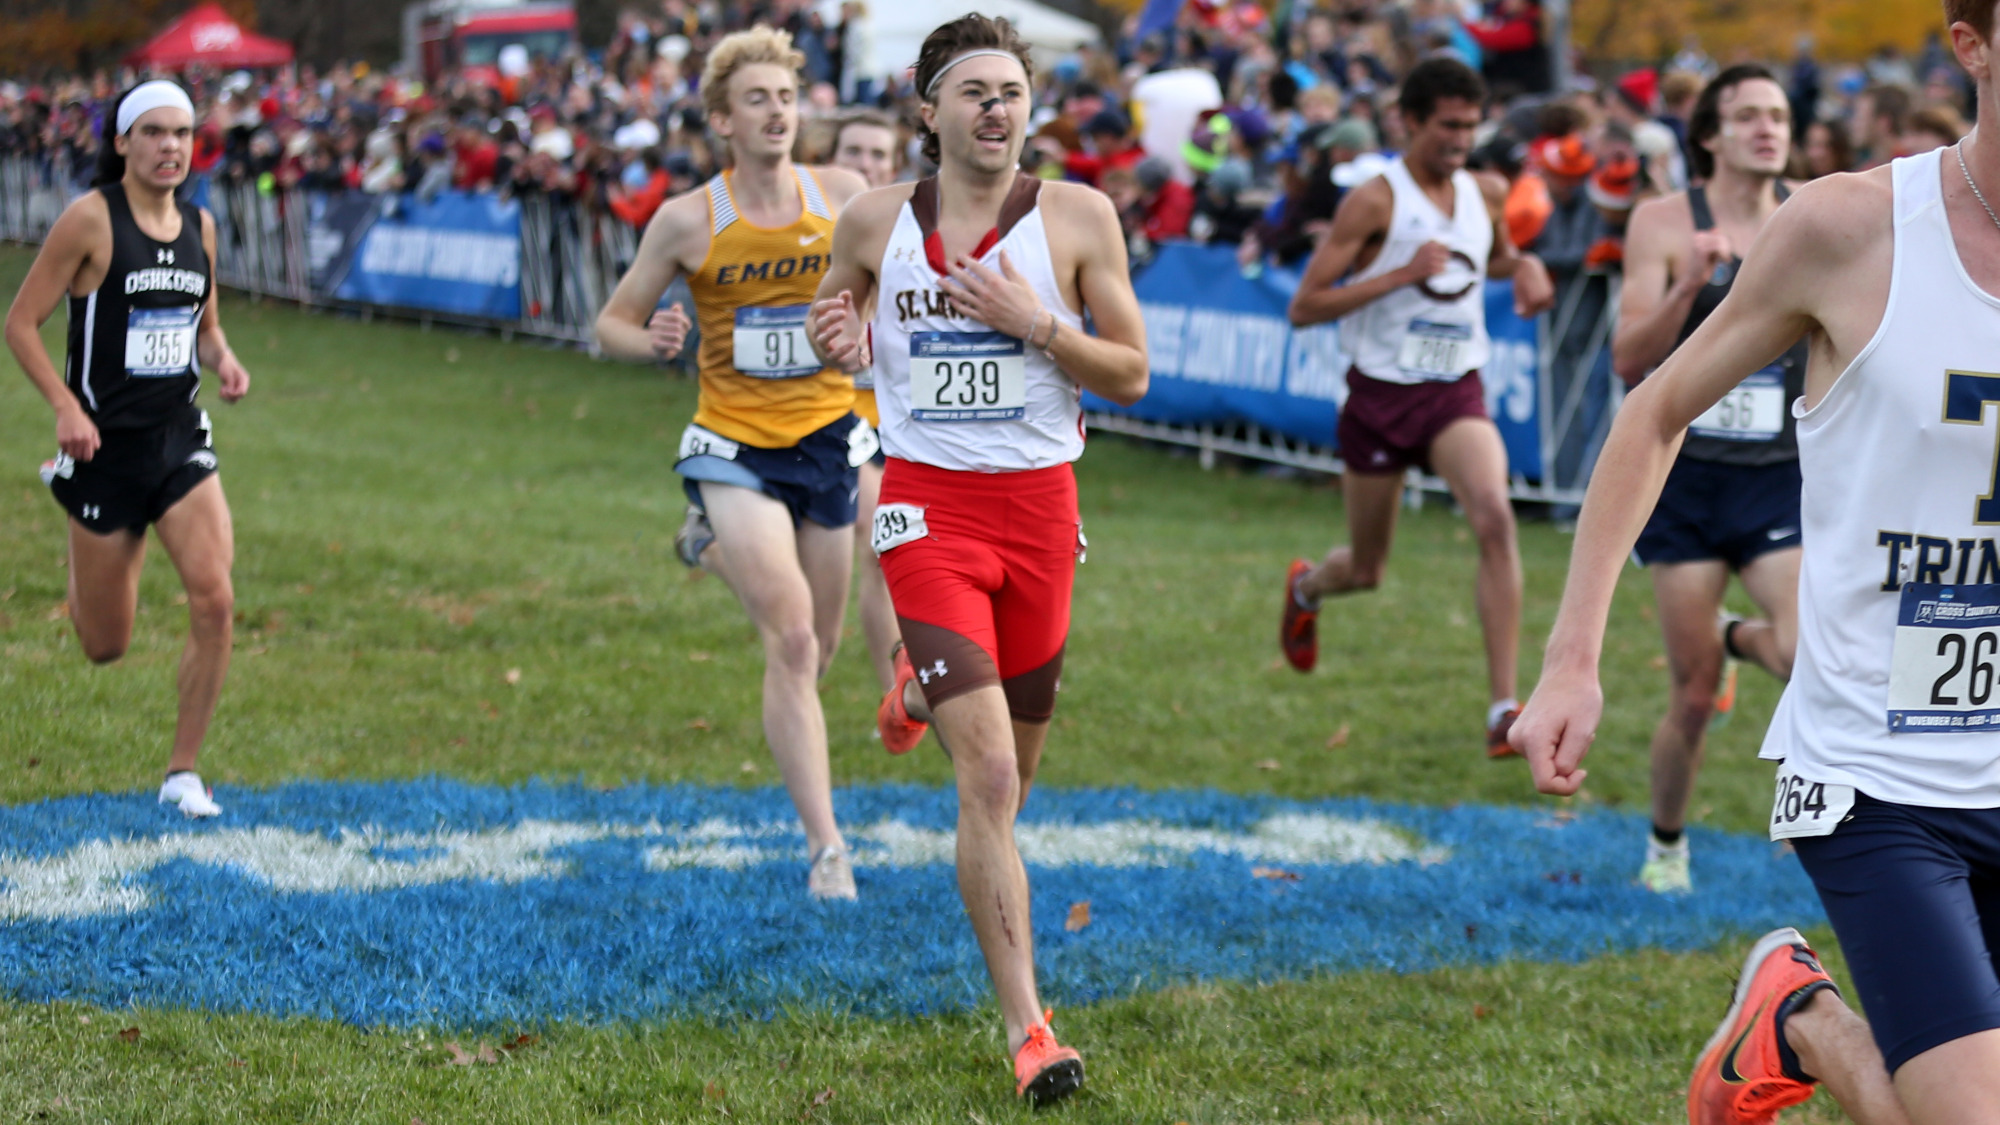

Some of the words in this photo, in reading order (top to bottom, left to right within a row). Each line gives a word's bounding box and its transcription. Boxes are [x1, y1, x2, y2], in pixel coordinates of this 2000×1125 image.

[125, 267, 205, 298] OSHKOSH
[896, 290, 921, 321] ST.
[144, 332, 182, 367] 355
[765, 331, 798, 367] 91
[935, 361, 999, 405] 239
[1719, 390, 1755, 429] 56
[1877, 529, 2000, 592] TRIN
[1930, 631, 2000, 706] 26
[1904, 715, 1951, 726] NOVEMBER
[1774, 774, 1827, 825] 264
